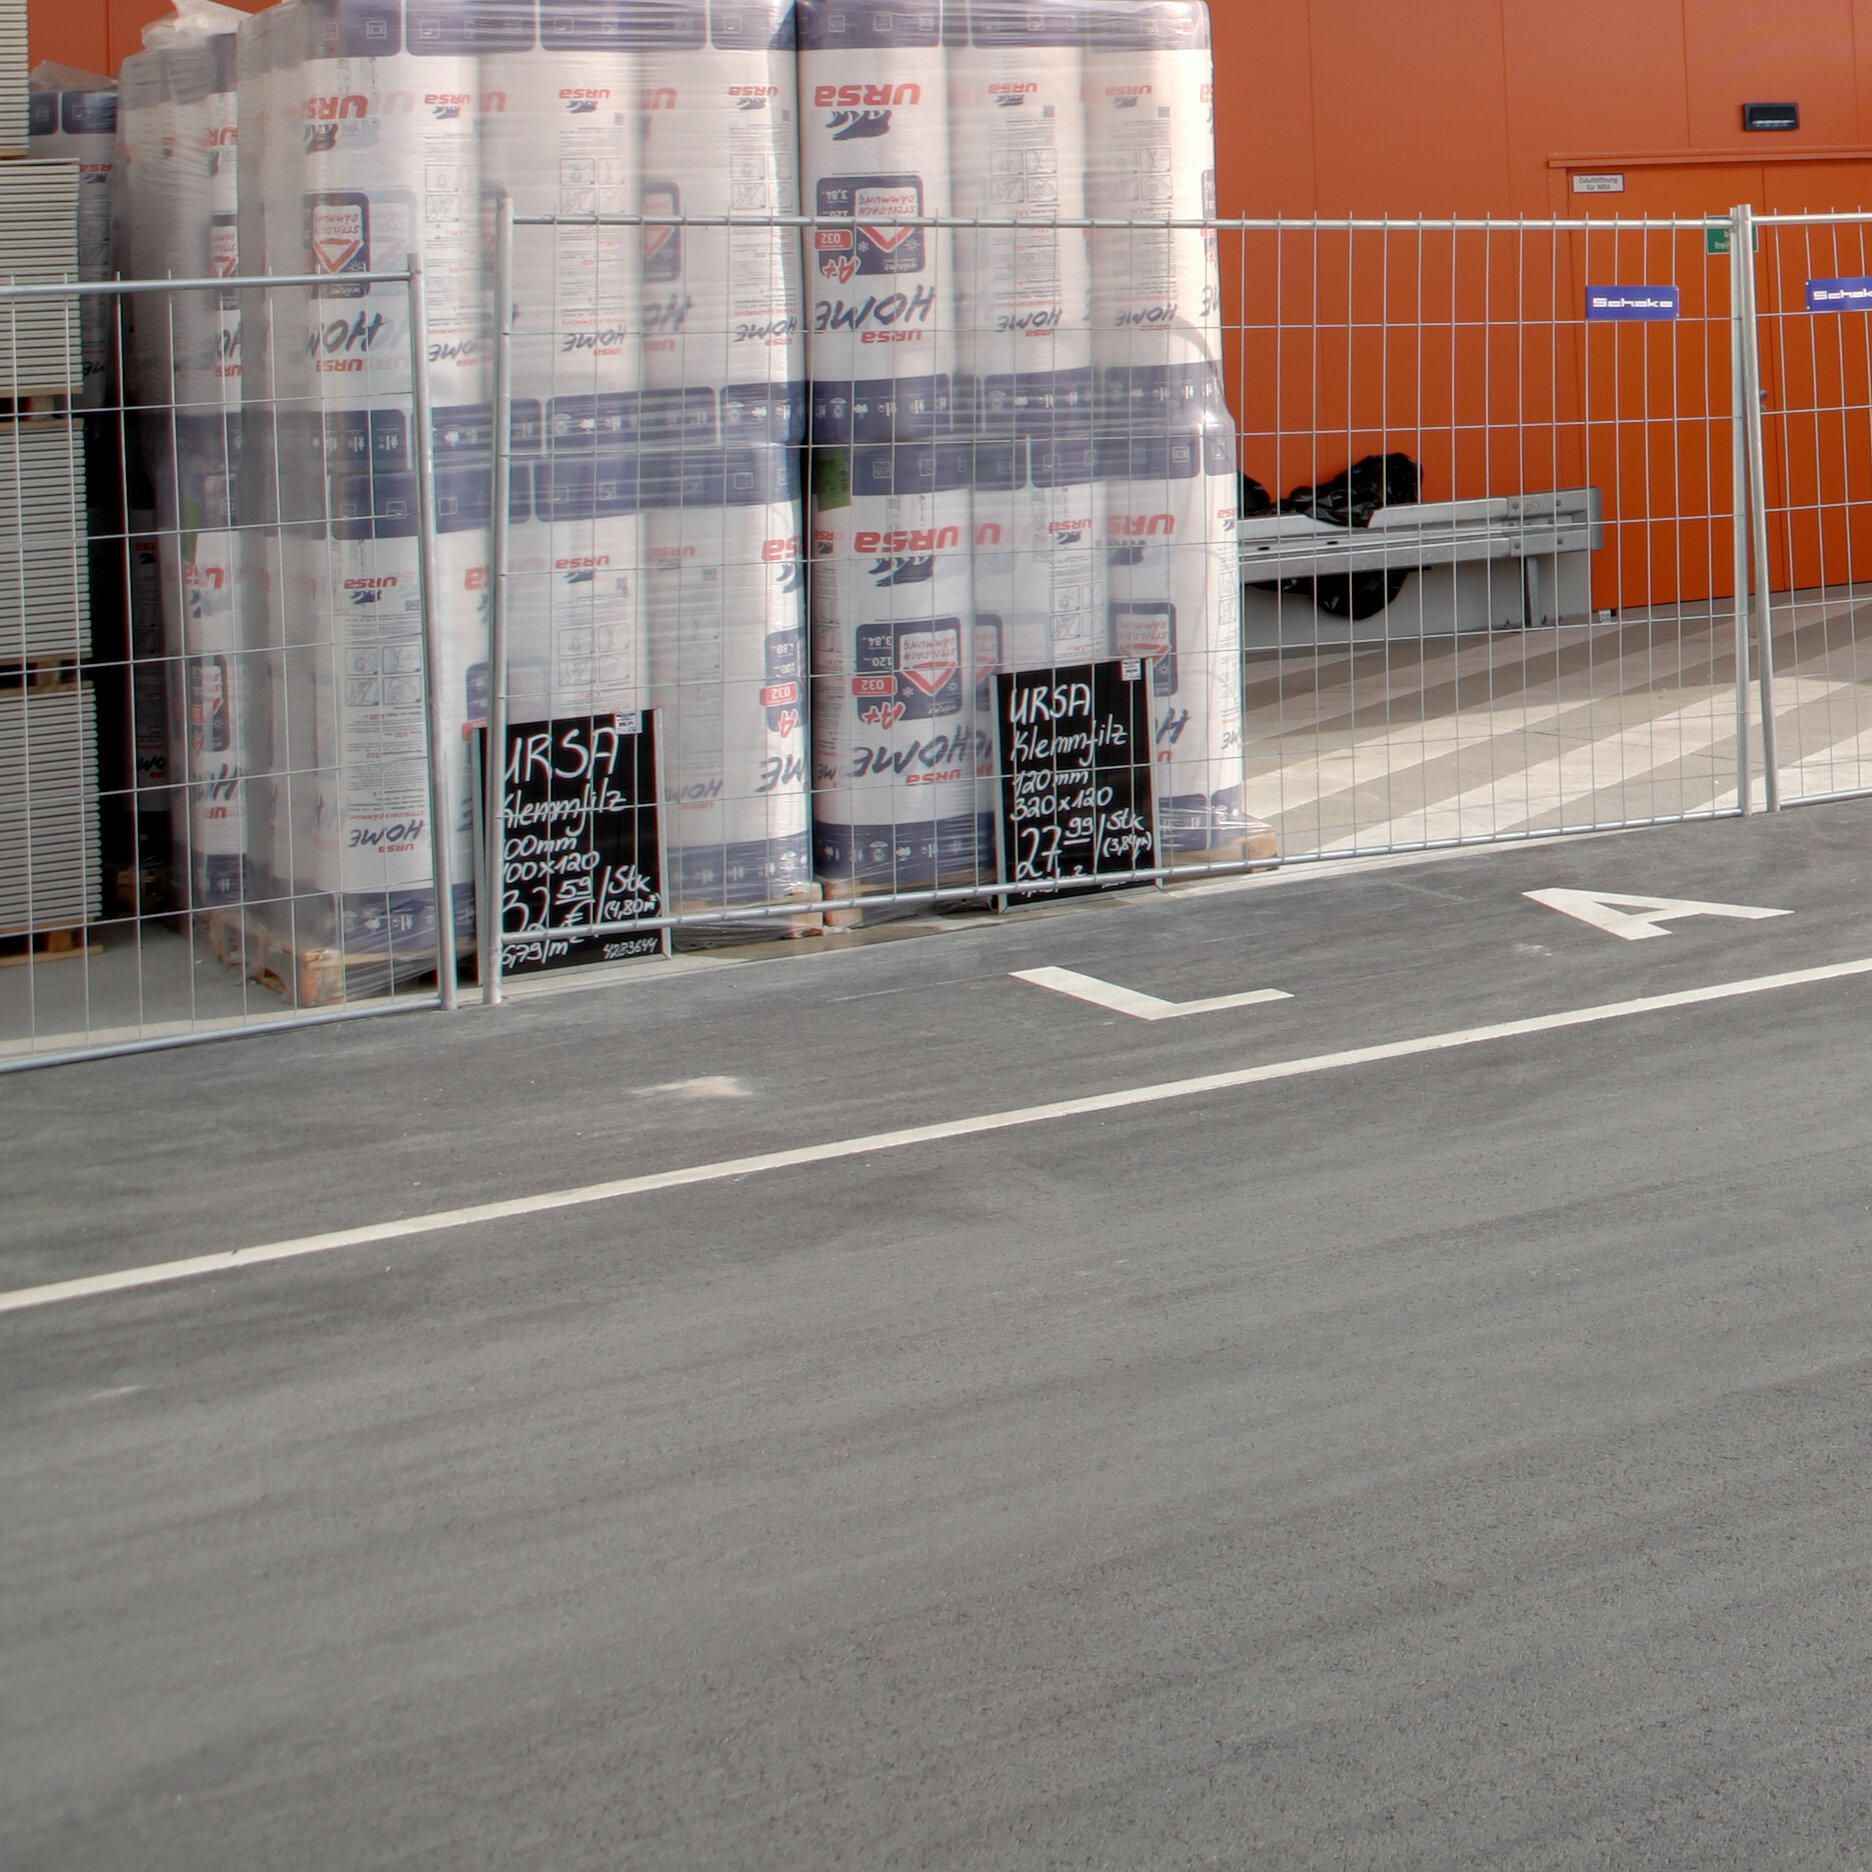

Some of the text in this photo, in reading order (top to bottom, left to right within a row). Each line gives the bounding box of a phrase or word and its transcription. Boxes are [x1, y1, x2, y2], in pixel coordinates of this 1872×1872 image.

[822, 256, 861, 285] A+
[814, 284, 936, 333] HOME
[997, 308, 1063, 331] HOME
[1113, 303, 1179, 327] HOME
[560, 326, 626, 354] HOME
[769, 687, 791, 699] 032
[859, 678, 885, 692] 032
[861, 701, 907, 730] A+
[1010, 682, 1091, 725] URSA
[852, 725, 981, 778] HOME
[1010, 714, 1129, 767] Klemmfilz
[1010, 786, 1113, 822] 320x120
[347, 818, 426, 850] HOME
[504, 836, 578, 862] 00mm
[1016, 825, 1062, 880] 27
